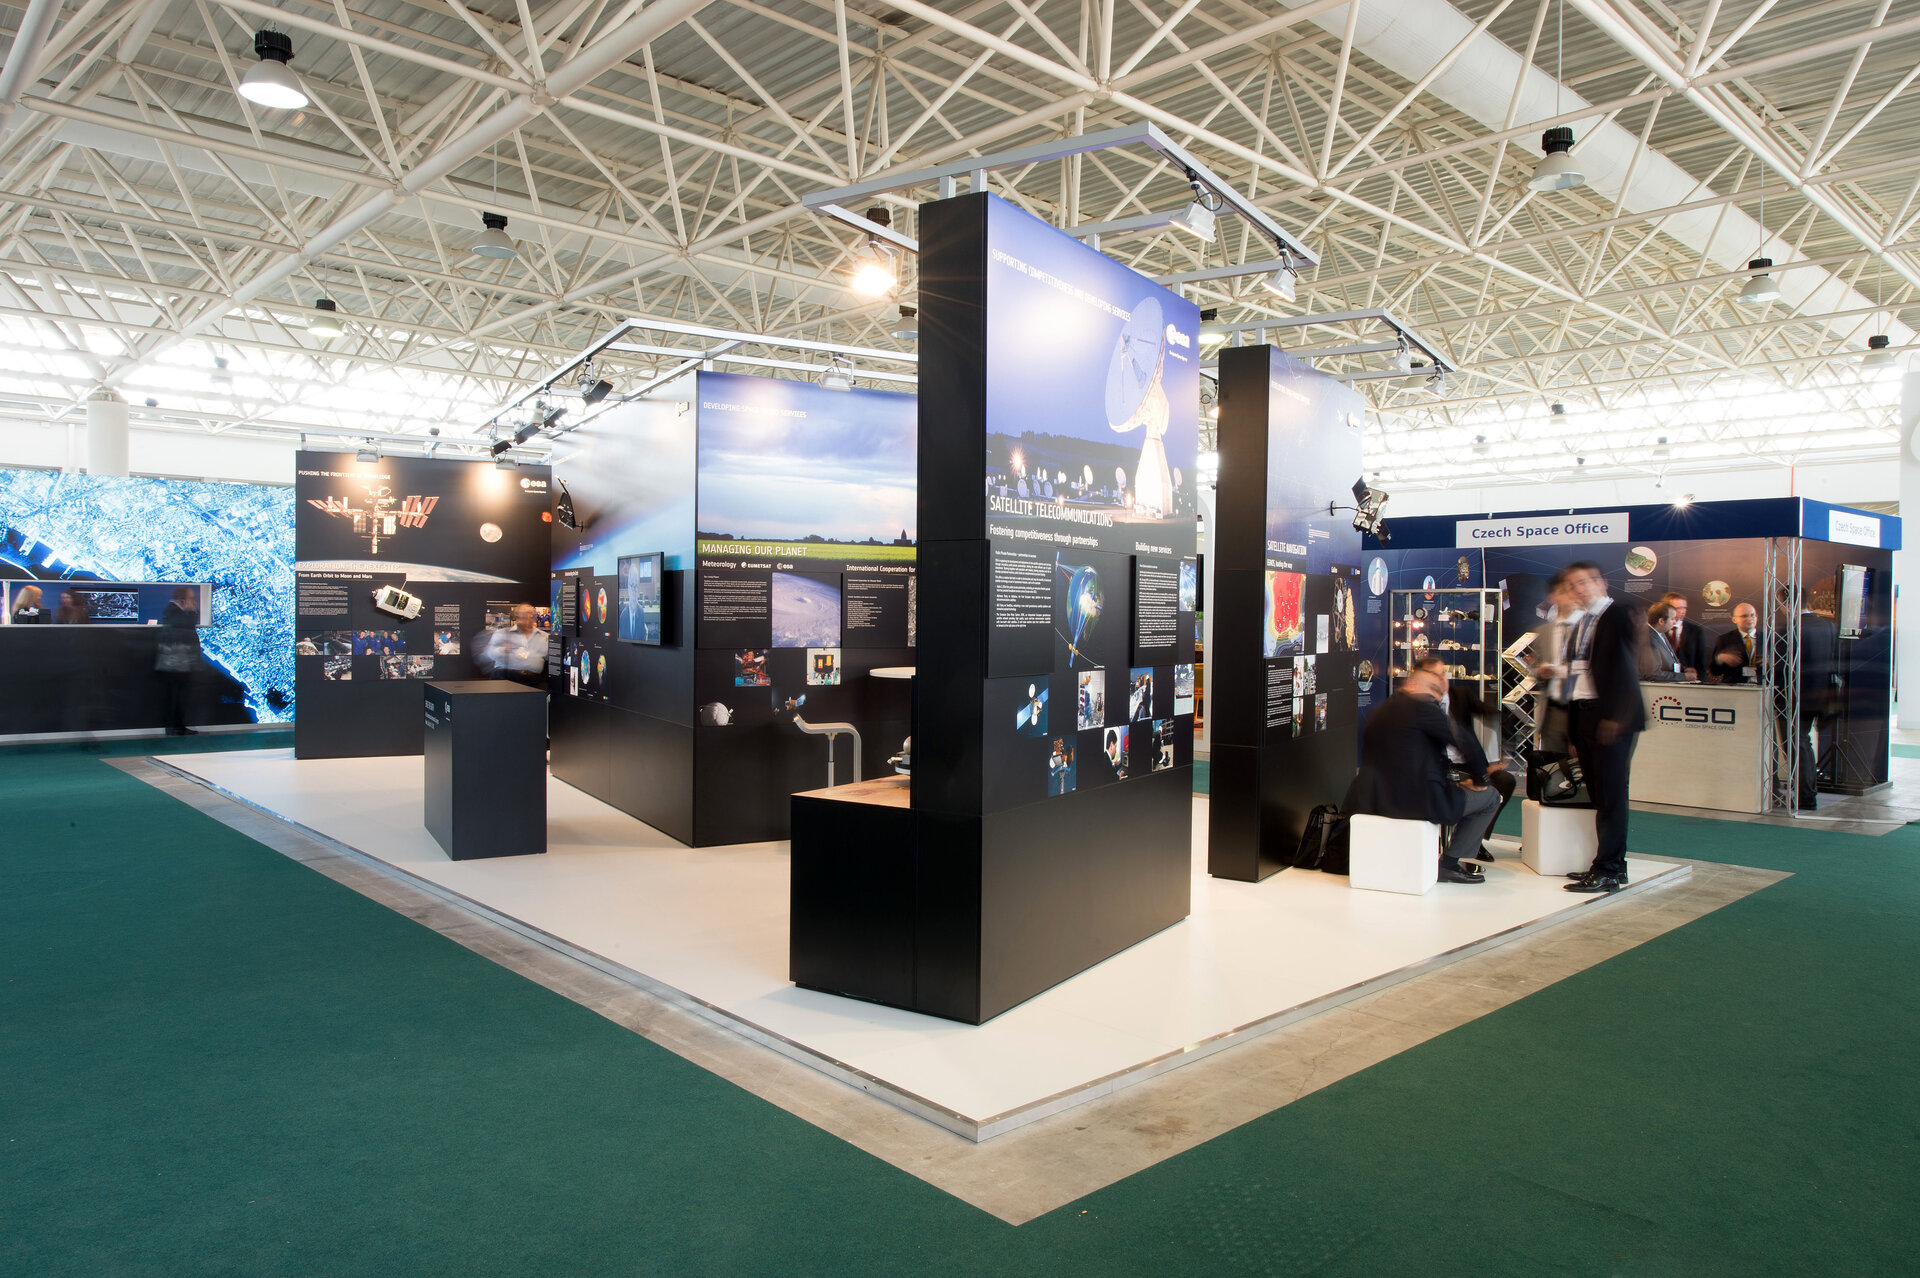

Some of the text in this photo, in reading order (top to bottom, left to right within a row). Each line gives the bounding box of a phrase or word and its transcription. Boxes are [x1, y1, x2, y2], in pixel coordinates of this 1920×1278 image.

[992, 248, 1028, 274] SUPPORTING
[1112, 305, 1131, 322] SERVICES
[703, 402, 740, 412] DEVELOPING
[781, 409, 807, 418] SERVICES
[530, 480, 547, 488] esa
[990, 495, 1113, 528] SATELLITE TELECOMMUNICATIONS
[990, 524, 1099, 548] Fostering competitiveness through partnerships
[1472, 523, 1609, 539] Czech Space Office
[703, 544, 807, 556] MANAGING OUR PLANET
[1136, 542, 1150, 554] Building
[1159, 546, 1172, 554] services
[702, 561, 736, 569] Meteorology
[1660, 706, 1736, 724] CSO
